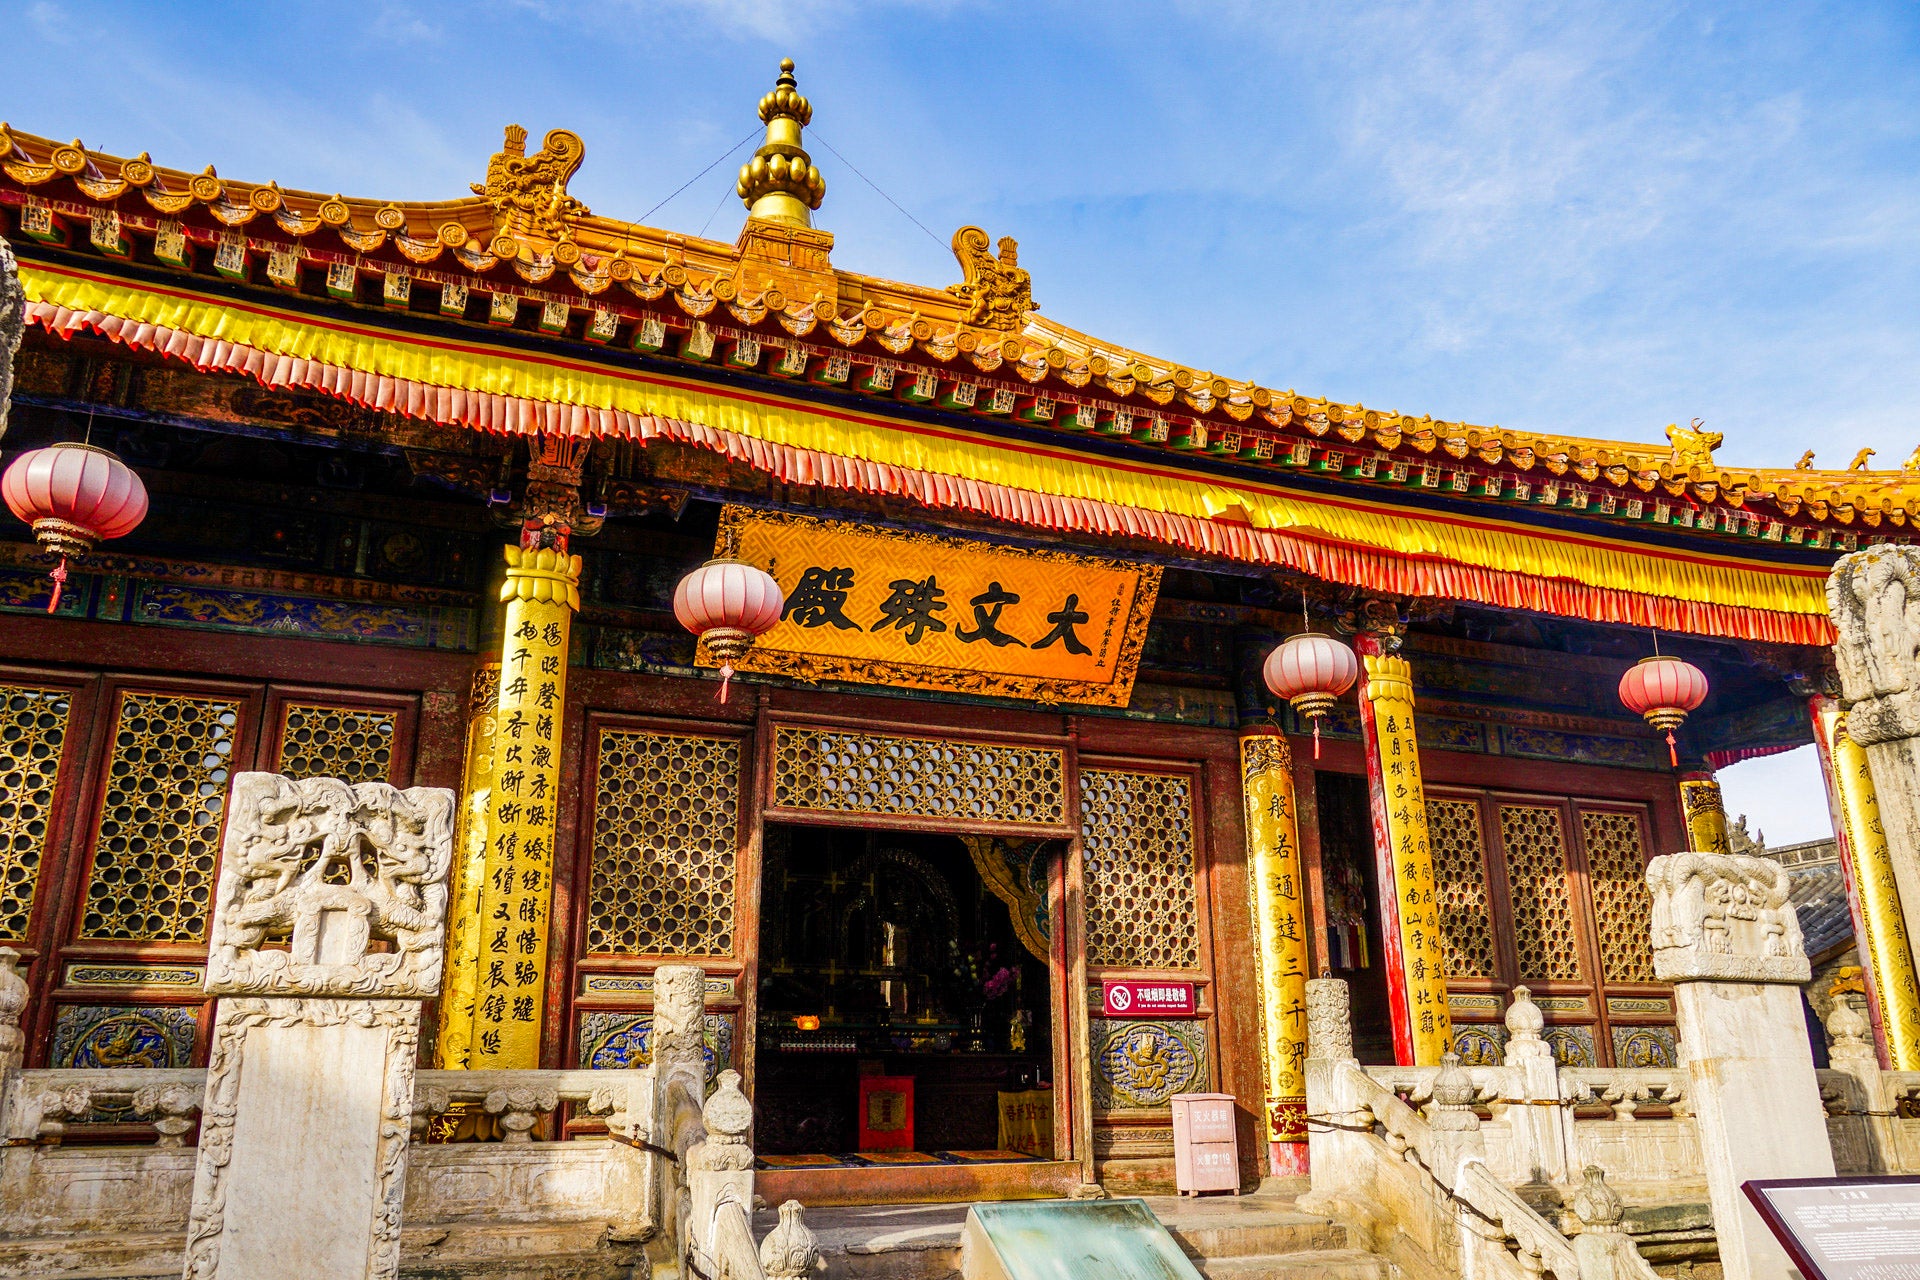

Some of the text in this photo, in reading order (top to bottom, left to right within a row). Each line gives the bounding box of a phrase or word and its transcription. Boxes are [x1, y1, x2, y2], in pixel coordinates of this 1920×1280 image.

[781, 566, 1093, 656] 大文殊殿
[1711, 833, 1733, 855] 林
[1267, 795, 1306, 1076] 般若通達三千界
[1136, 988, 1187, 1002] 不吸烟即是敬佛
